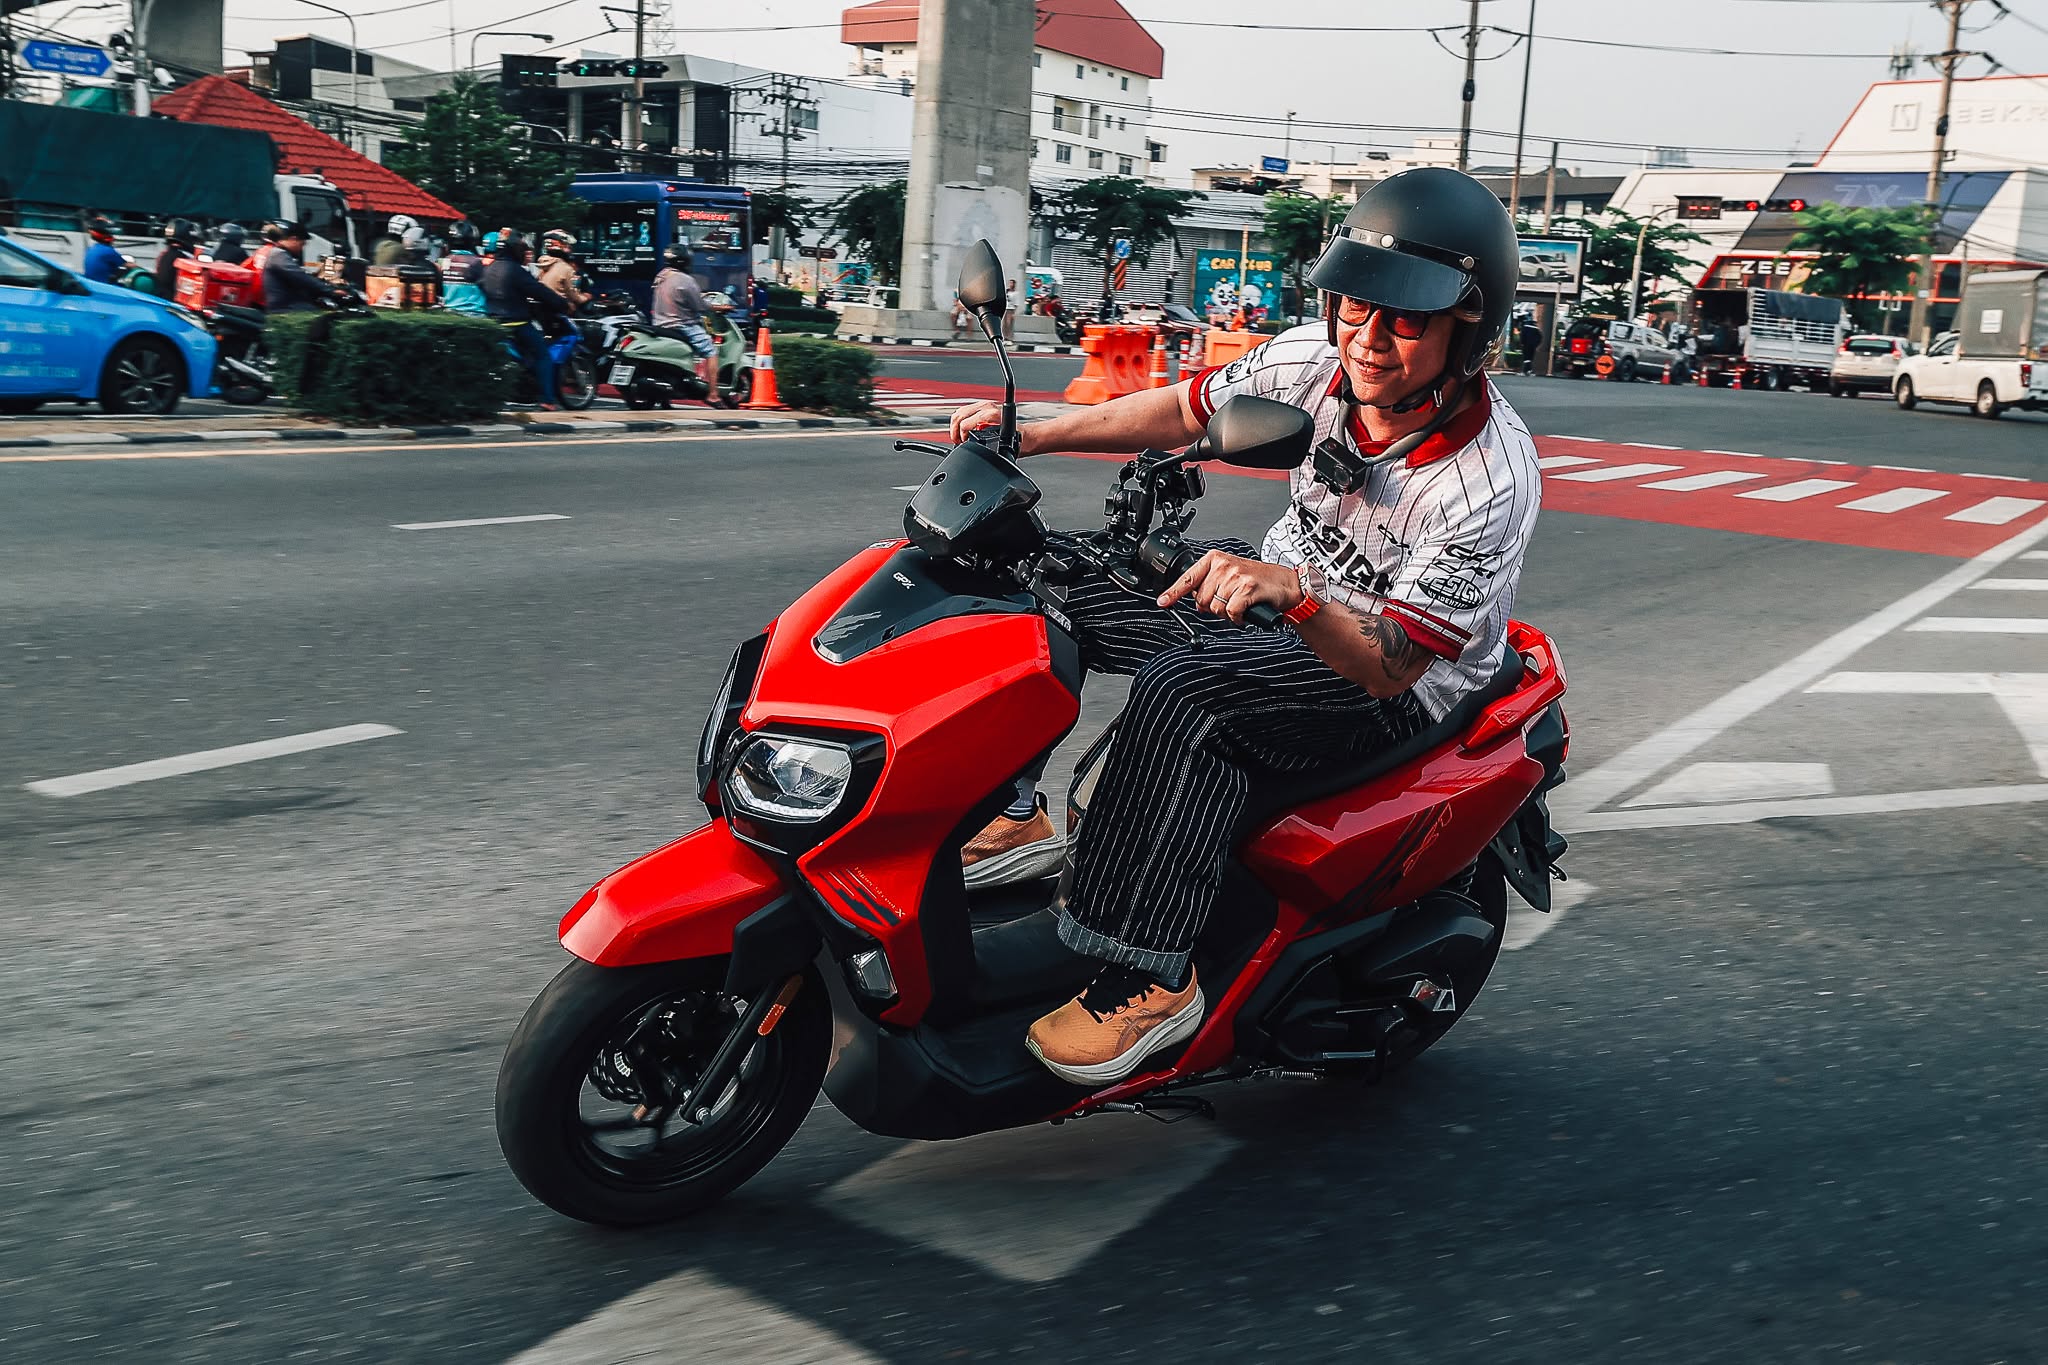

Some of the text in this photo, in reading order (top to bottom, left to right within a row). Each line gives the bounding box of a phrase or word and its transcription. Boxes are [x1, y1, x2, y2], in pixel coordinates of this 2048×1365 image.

[1929, 104, 2048, 124] EEKR
[1210, 258, 1236, 269] CAR
[1741, 260, 1792, 276] ZEE
[893, 572, 916, 590] GPX
